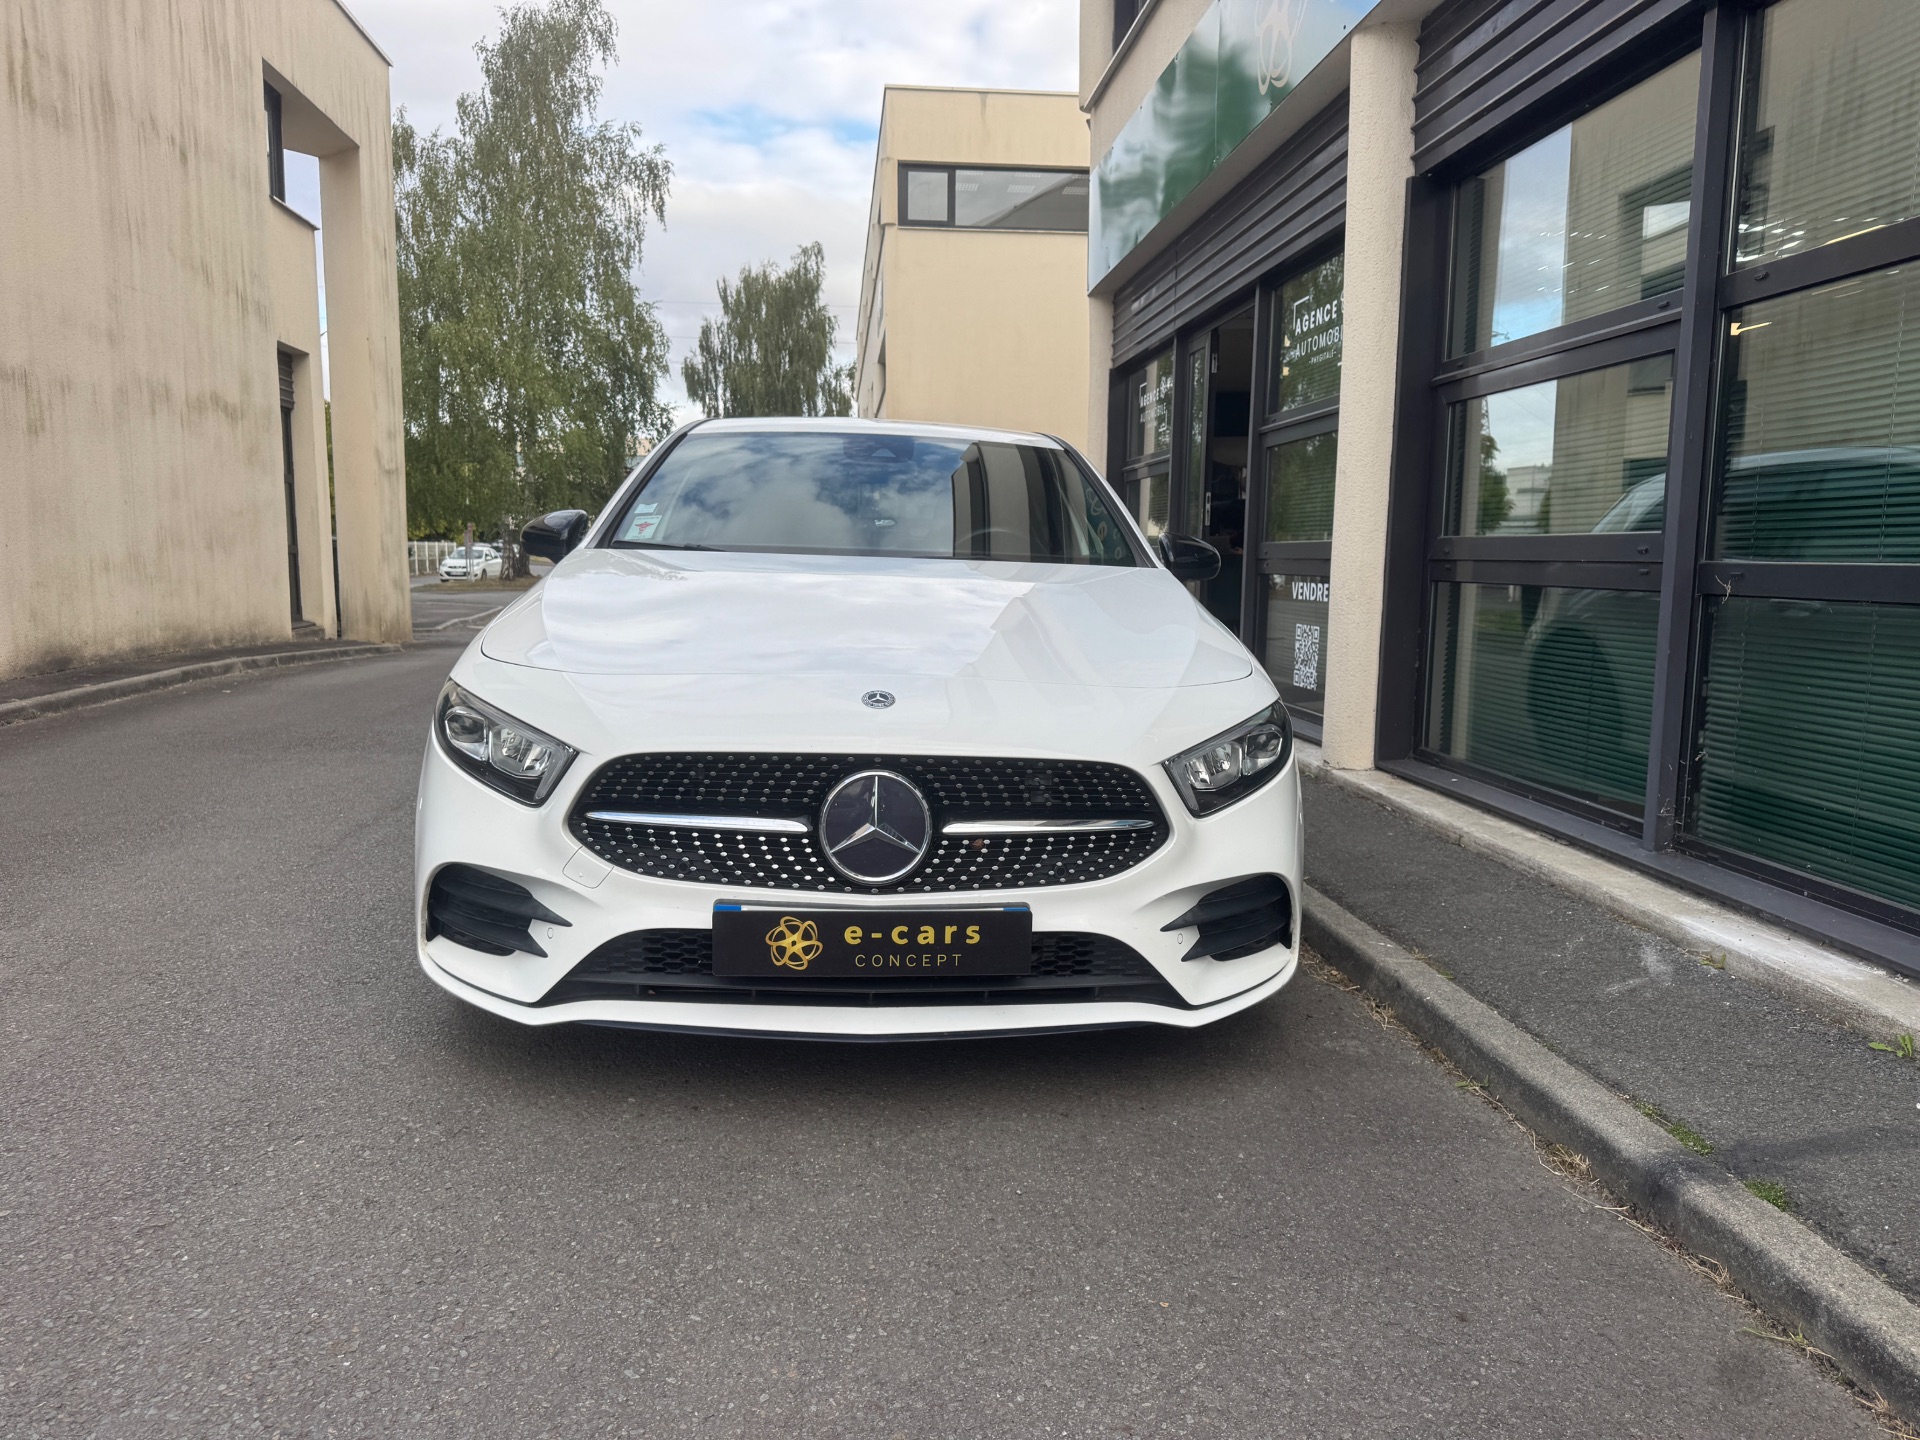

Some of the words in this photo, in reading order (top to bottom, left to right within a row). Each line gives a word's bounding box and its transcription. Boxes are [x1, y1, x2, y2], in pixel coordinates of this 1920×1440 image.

[1295, 299, 1338, 336] AGENCE
[1291, 581, 1329, 602] VENDRE
[844, 925, 981, 945] e-cars
[855, 954, 962, 967] CONCEPT
